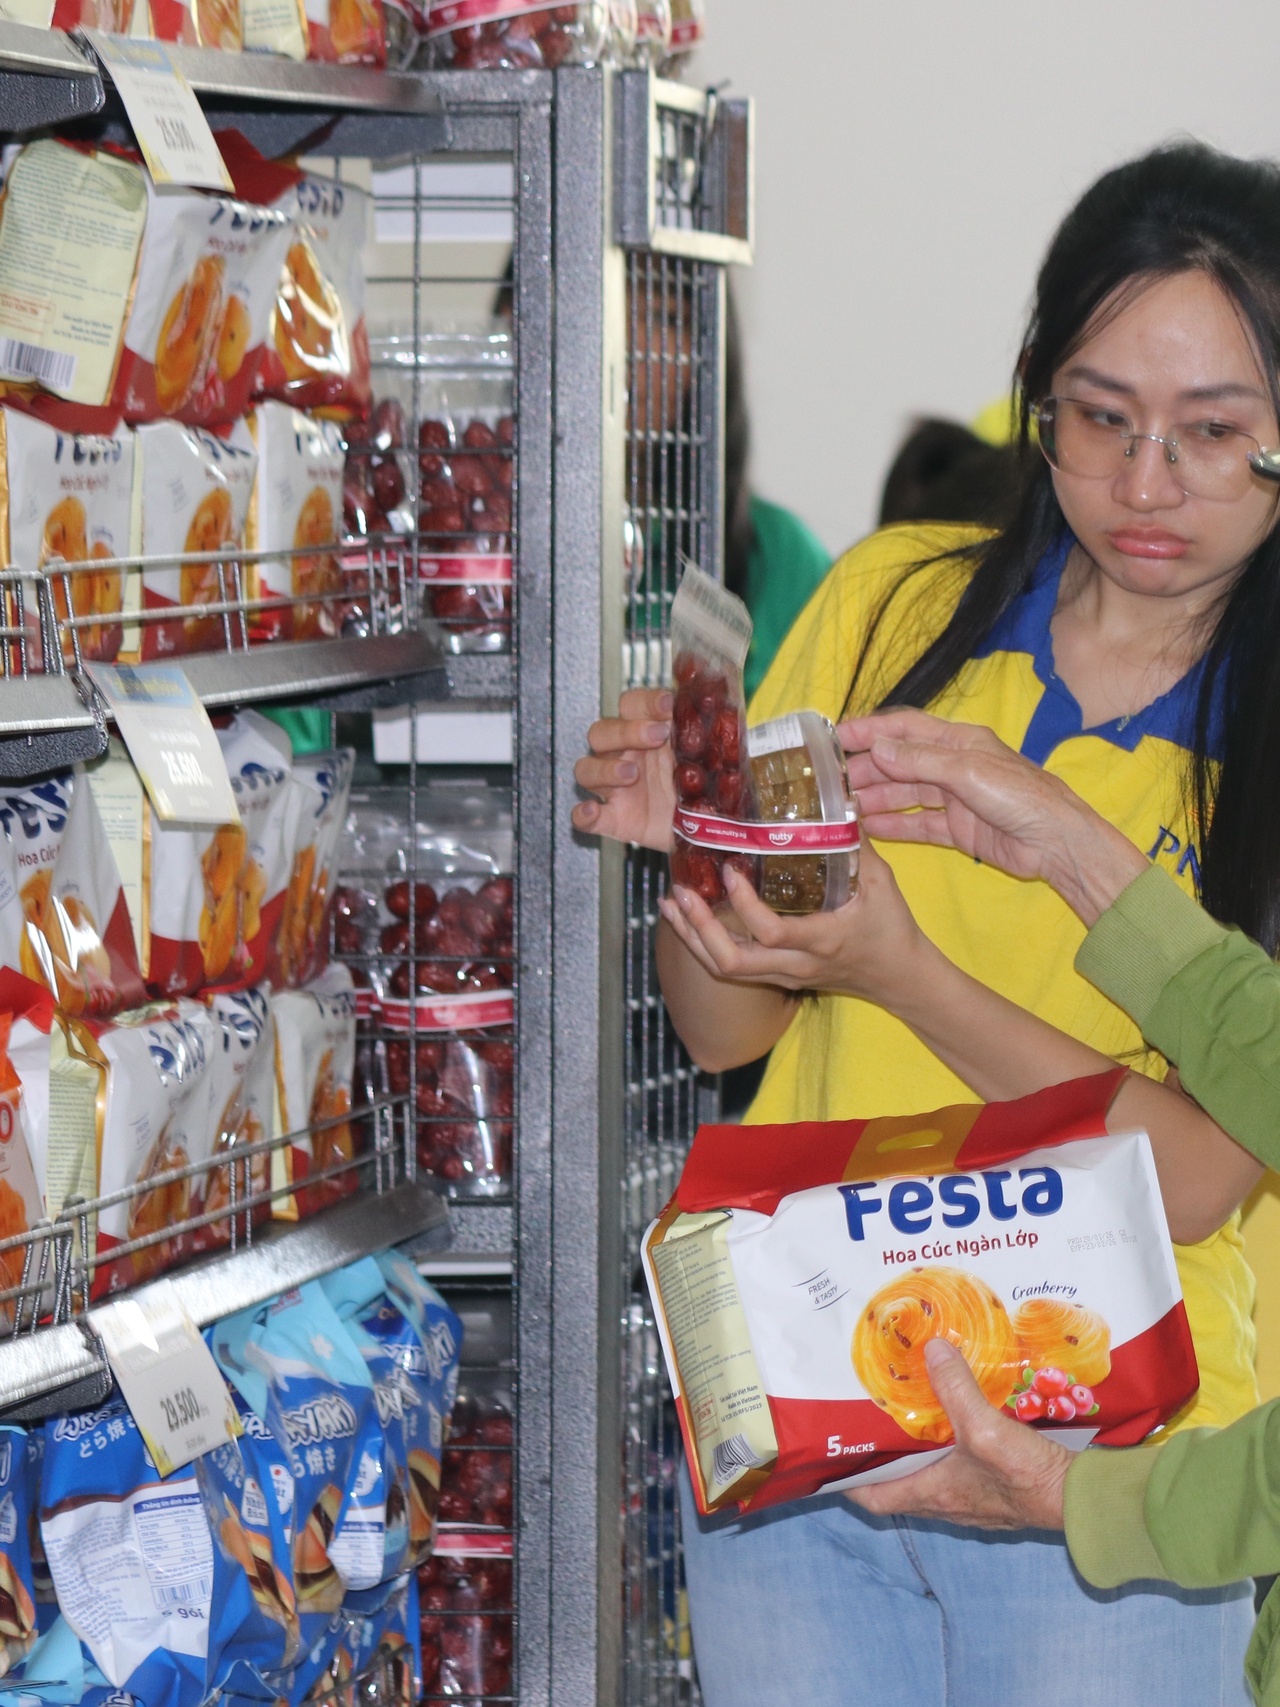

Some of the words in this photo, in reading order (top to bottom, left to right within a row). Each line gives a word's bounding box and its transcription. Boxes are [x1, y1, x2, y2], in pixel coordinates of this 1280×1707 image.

[769, 832, 795, 846] nutty
[837, 1166, 1064, 1242] Festa
[882, 1249, 917, 1266] Hoa
[921, 1240, 953, 1260] Cúc
[956, 1234, 1001, 1257] Ngàn
[1006, 1229, 1039, 1249] Lớp
[808, 1277, 831, 1296] FRESH
[820, 1285, 838, 1302] TASTY
[1012, 1280, 1078, 1301] Cranberry
[826, 1435, 842, 1457] 5
[842, 1442, 876, 1455] PACKS
